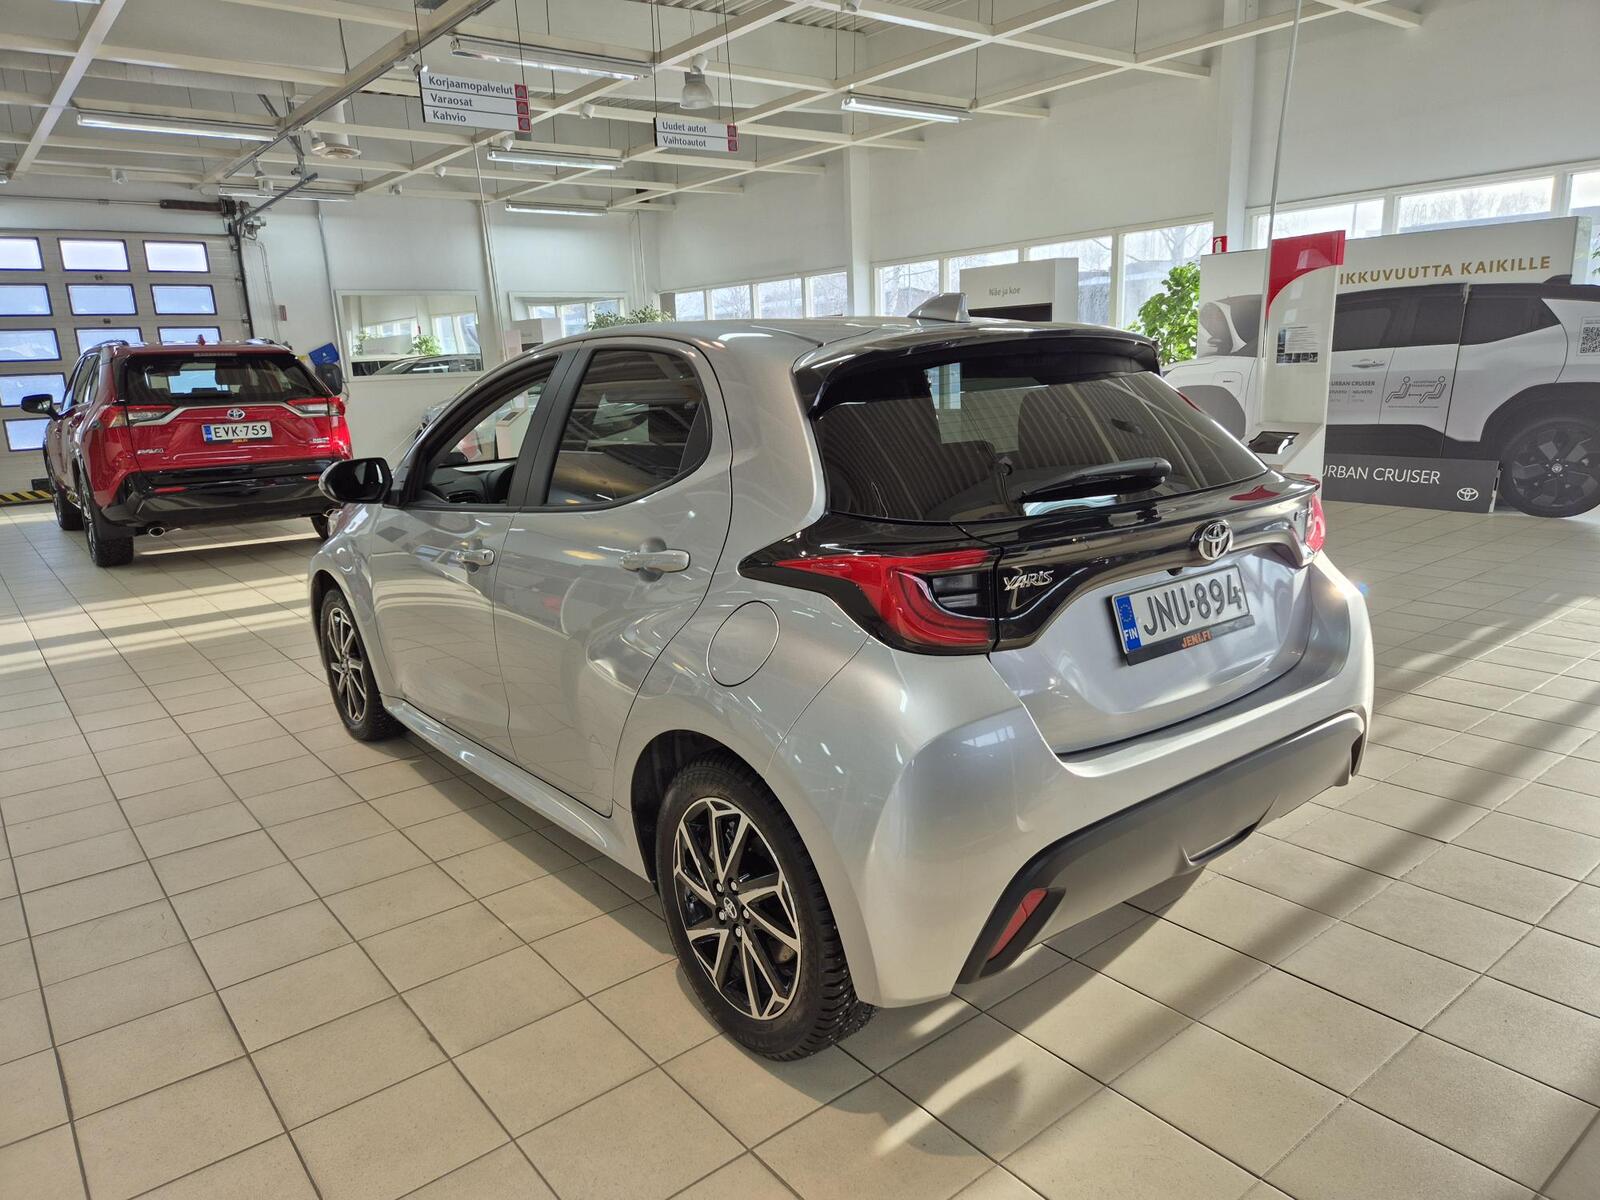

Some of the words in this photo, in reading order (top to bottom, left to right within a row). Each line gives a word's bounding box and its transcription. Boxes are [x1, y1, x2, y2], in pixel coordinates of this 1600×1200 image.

[429, 75, 513, 95] Korjaamopalvelut
[430, 93, 473, 107] Varaosat
[432, 110, 467, 123] Kahvio
[662, 121, 685, 132] Uudet
[687, 124, 707, 133] autot
[662, 135, 707, 147] Vaihtoautot
[1460, 256, 1551, 275] KAIKILLE
[1372, 467, 1441, 484] CRUISER
[1003, 570, 1055, 592] YARIS
[1143, 574, 1242, 636] JNU-894
[1123, 626, 1138, 642] FIN
